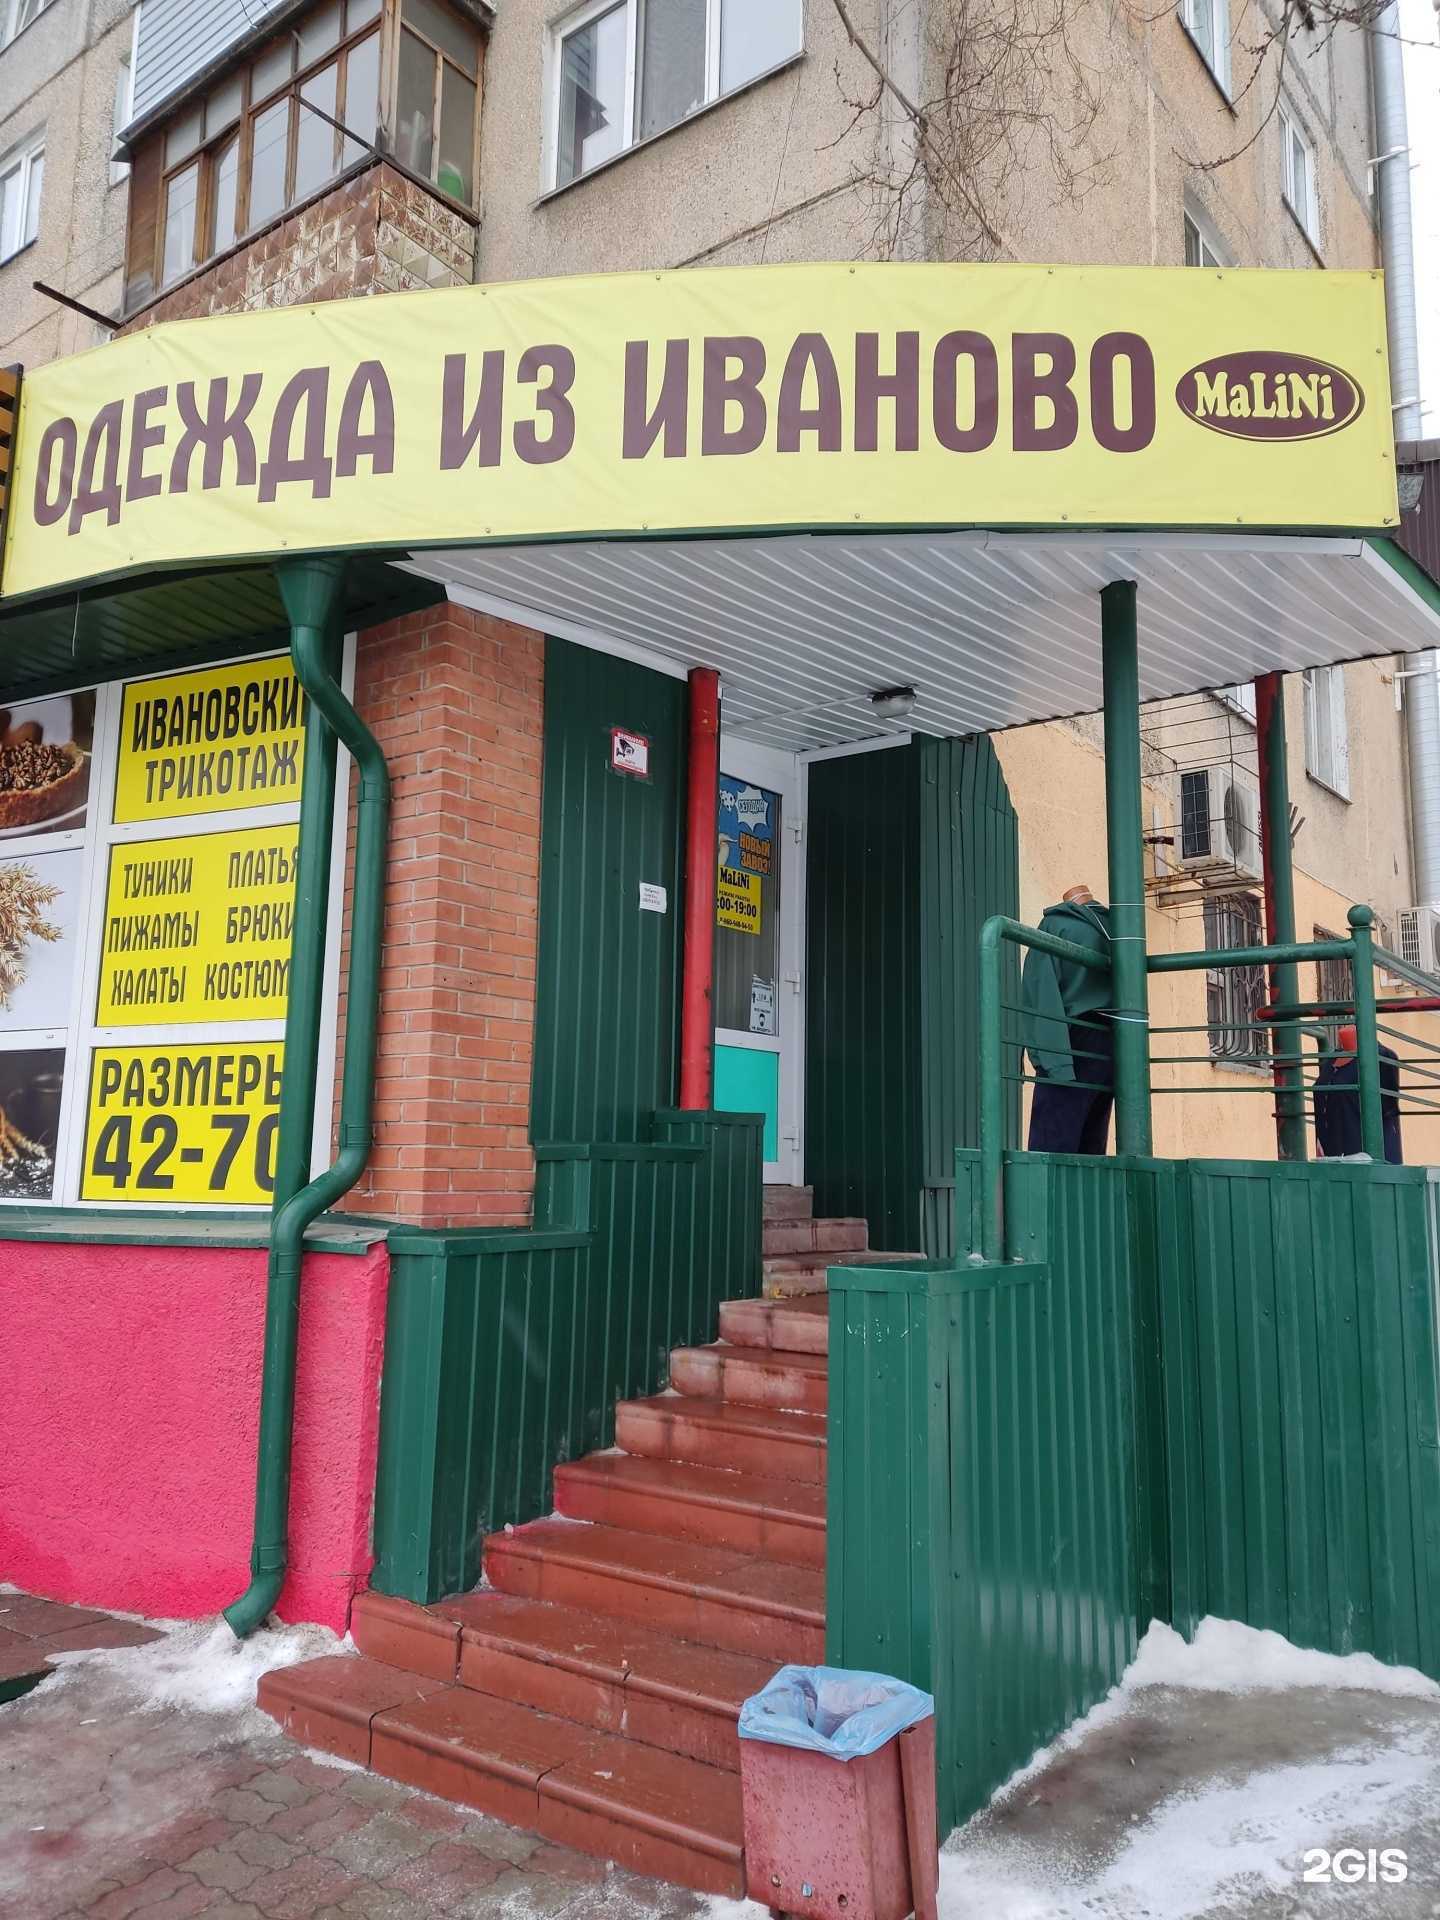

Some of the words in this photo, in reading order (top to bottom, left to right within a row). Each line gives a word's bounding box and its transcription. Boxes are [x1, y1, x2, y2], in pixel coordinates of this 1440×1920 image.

[1194, 371, 1335, 420] MaLiNi
[33, 359, 395, 536] ОДЕЖДА
[439, 344, 576, 471] ИЗ
[621, 330, 1157, 460] ИВАНОВО
[131, 675, 305, 753] ИВАНОВСКИ
[145, 739, 299, 804] ТРИКОТАЖ
[123, 857, 194, 899] ТУНИКИ
[720, 867, 750, 890] MaLiNi
[717, 896, 757, 918] :00-19:00
[107, 910, 200, 953] ПИЖАМЫ
[110, 965, 187, 1006] ХАЛАТЫ
[203, 958, 291, 1001] КОСТЮМ
